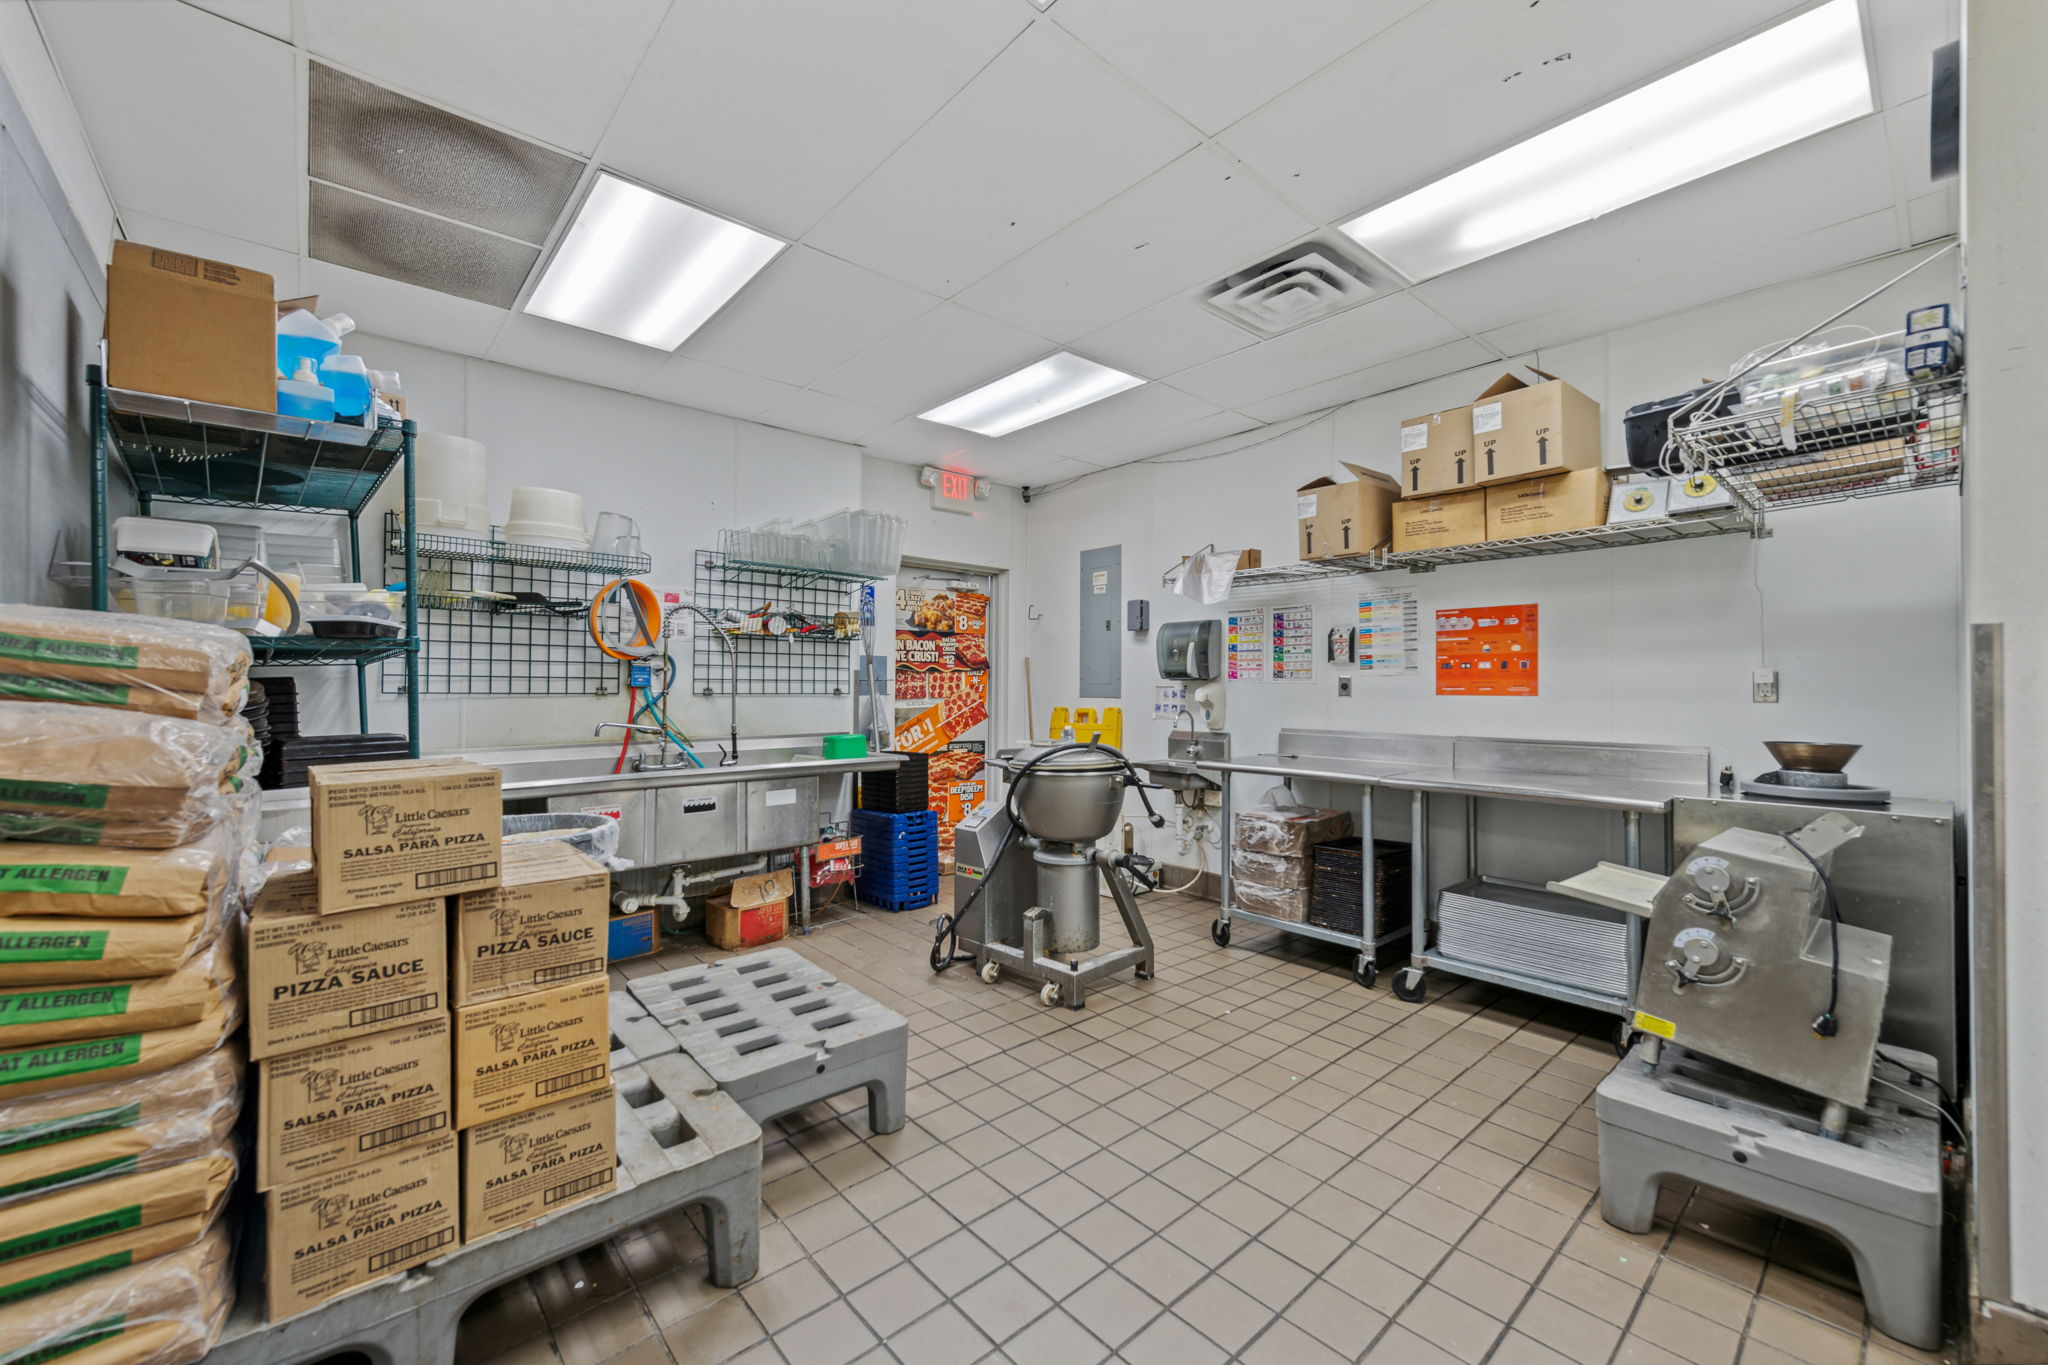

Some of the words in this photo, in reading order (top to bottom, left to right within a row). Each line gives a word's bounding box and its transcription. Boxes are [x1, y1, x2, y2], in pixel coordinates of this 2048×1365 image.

[1536, 428, 1550, 436] UP
[1484, 440, 1496, 448] UP
[1410, 458, 1421, 466] UP
[942, 472, 969, 501] EXIT
[906, 640, 936, 651] BACON
[908, 652, 939, 662] CRUST!
[395, 812, 426, 824] Little
[427, 808, 471, 820] Caesars
[392, 826, 442, 838] California
[344, 844, 394, 859] SALSA
[400, 836, 440, 852] PARA
[445, 833, 485, 846] PIZZA
[14, 868, 111, 883] ALLERGEN
[520, 914, 544, 925] Little
[546, 908, 584, 920] Caesars
[328, 946, 360, 960] Little
[362, 938, 409, 952] Caesars
[477, 939, 531, 958] PIZZA
[538, 927, 594, 948] SAUCE
[274, 976, 343, 1000] PIZZA
[351, 958, 424, 985] SAUCE
[324, 962, 378, 977] California
[17, 990, 115, 1012] ALLERGEN
[520, 1024, 546, 1038] Little
[546, 1016, 584, 1030] Caesars
[28, 1041, 125, 1068] ALLERGEN
[476, 1058, 518, 1076] SALSA
[523, 1050, 558, 1064] PARA
[561, 1038, 596, 1054] PIZZA
[339, 1070, 372, 1087] Little
[374, 1059, 420, 1078] Caesars
[284, 1110, 338, 1130] SALSA
[344, 1096, 387, 1116] PARA
[392, 1084, 434, 1102] PIZZA
[528, 1132, 554, 1148] Little
[556, 1122, 592, 1139] Caesars
[485, 1168, 528, 1190] SALSA
[532, 1156, 565, 1173] PARA
[569, 1143, 604, 1160] PIZZA
[350, 1193, 382, 1211] Little
[383, 1178, 428, 1198] Caesars
[294, 1234, 348, 1260] SALSA
[354, 1217, 396, 1238] PARA
[400, 1200, 442, 1222] PIZZA
